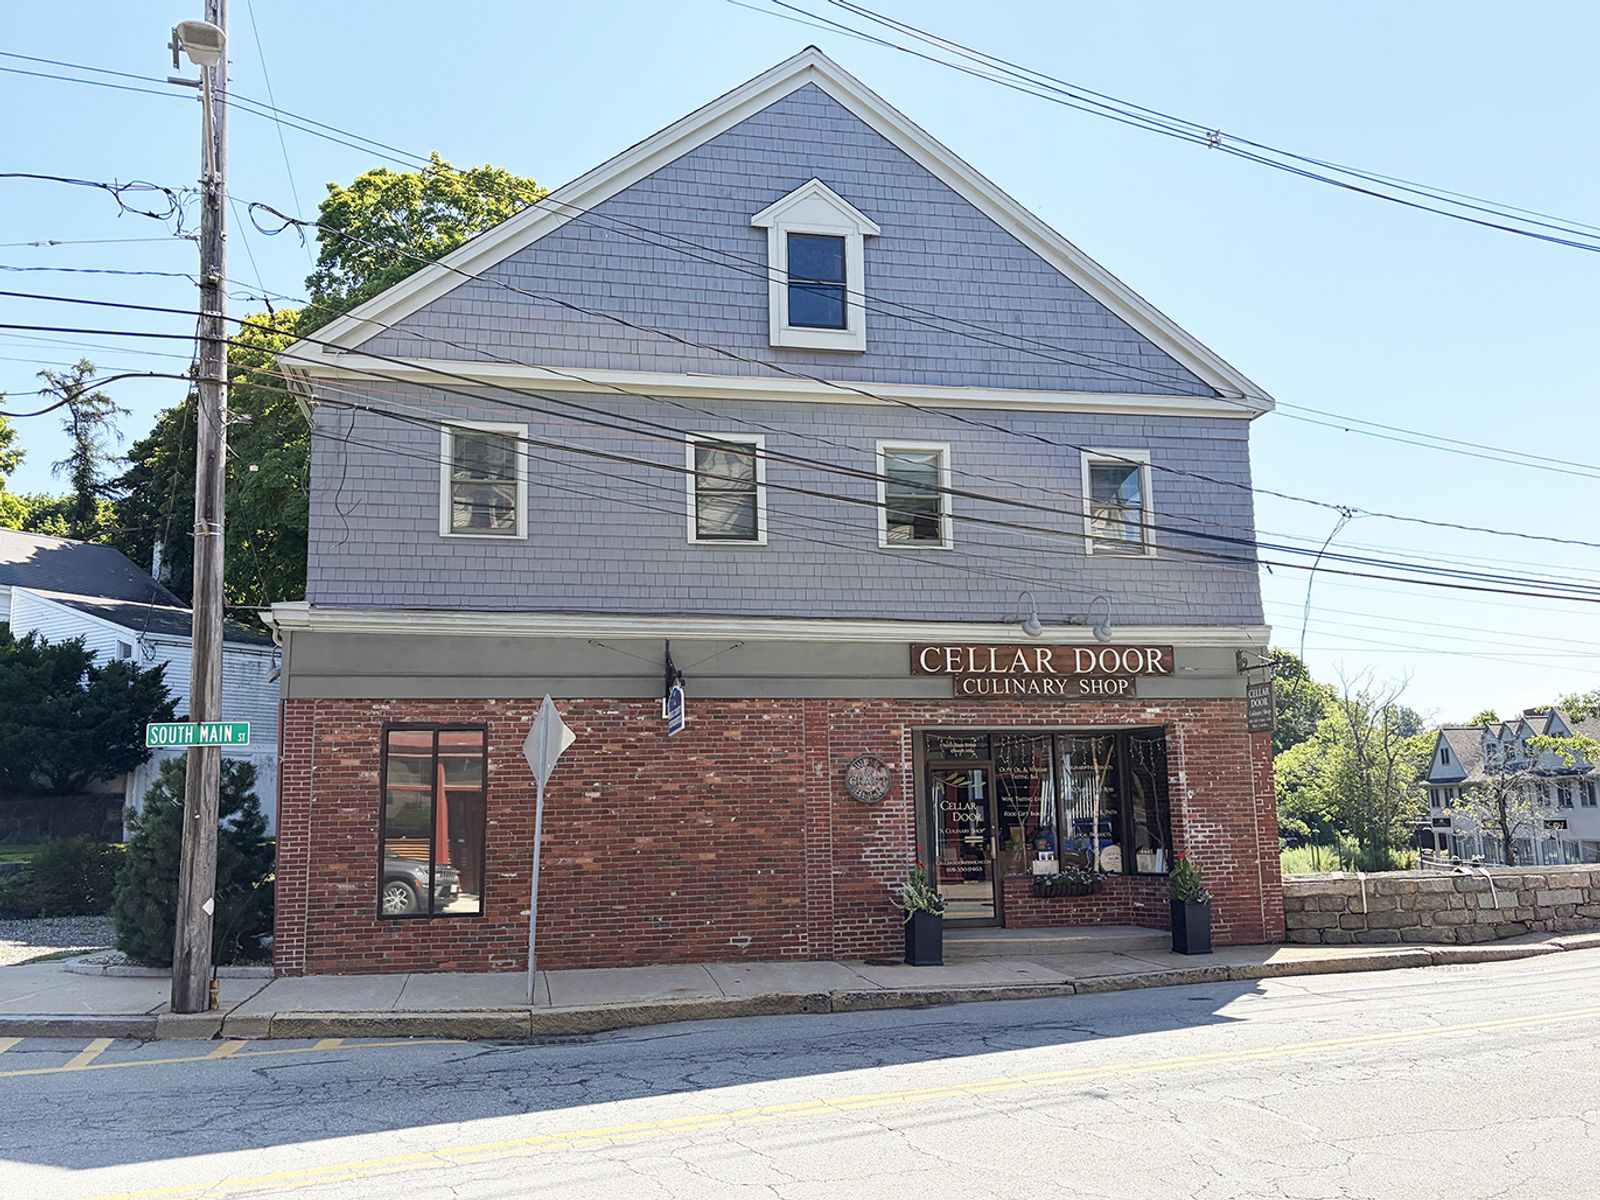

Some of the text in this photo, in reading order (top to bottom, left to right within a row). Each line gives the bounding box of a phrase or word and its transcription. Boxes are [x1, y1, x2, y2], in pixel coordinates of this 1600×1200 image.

[919, 646, 1168, 674] CELLAR DOOR
[962, 677, 1129, 696] CULINARY SHOP
[1248, 687, 1270, 698] CELLAR
[1250, 697, 1269, 708] DOOR
[150, 725, 246, 744] SOUTH MAIN ST
[940, 800, 977, 811] CELLAR
[953, 812, 984, 822] DOOR
